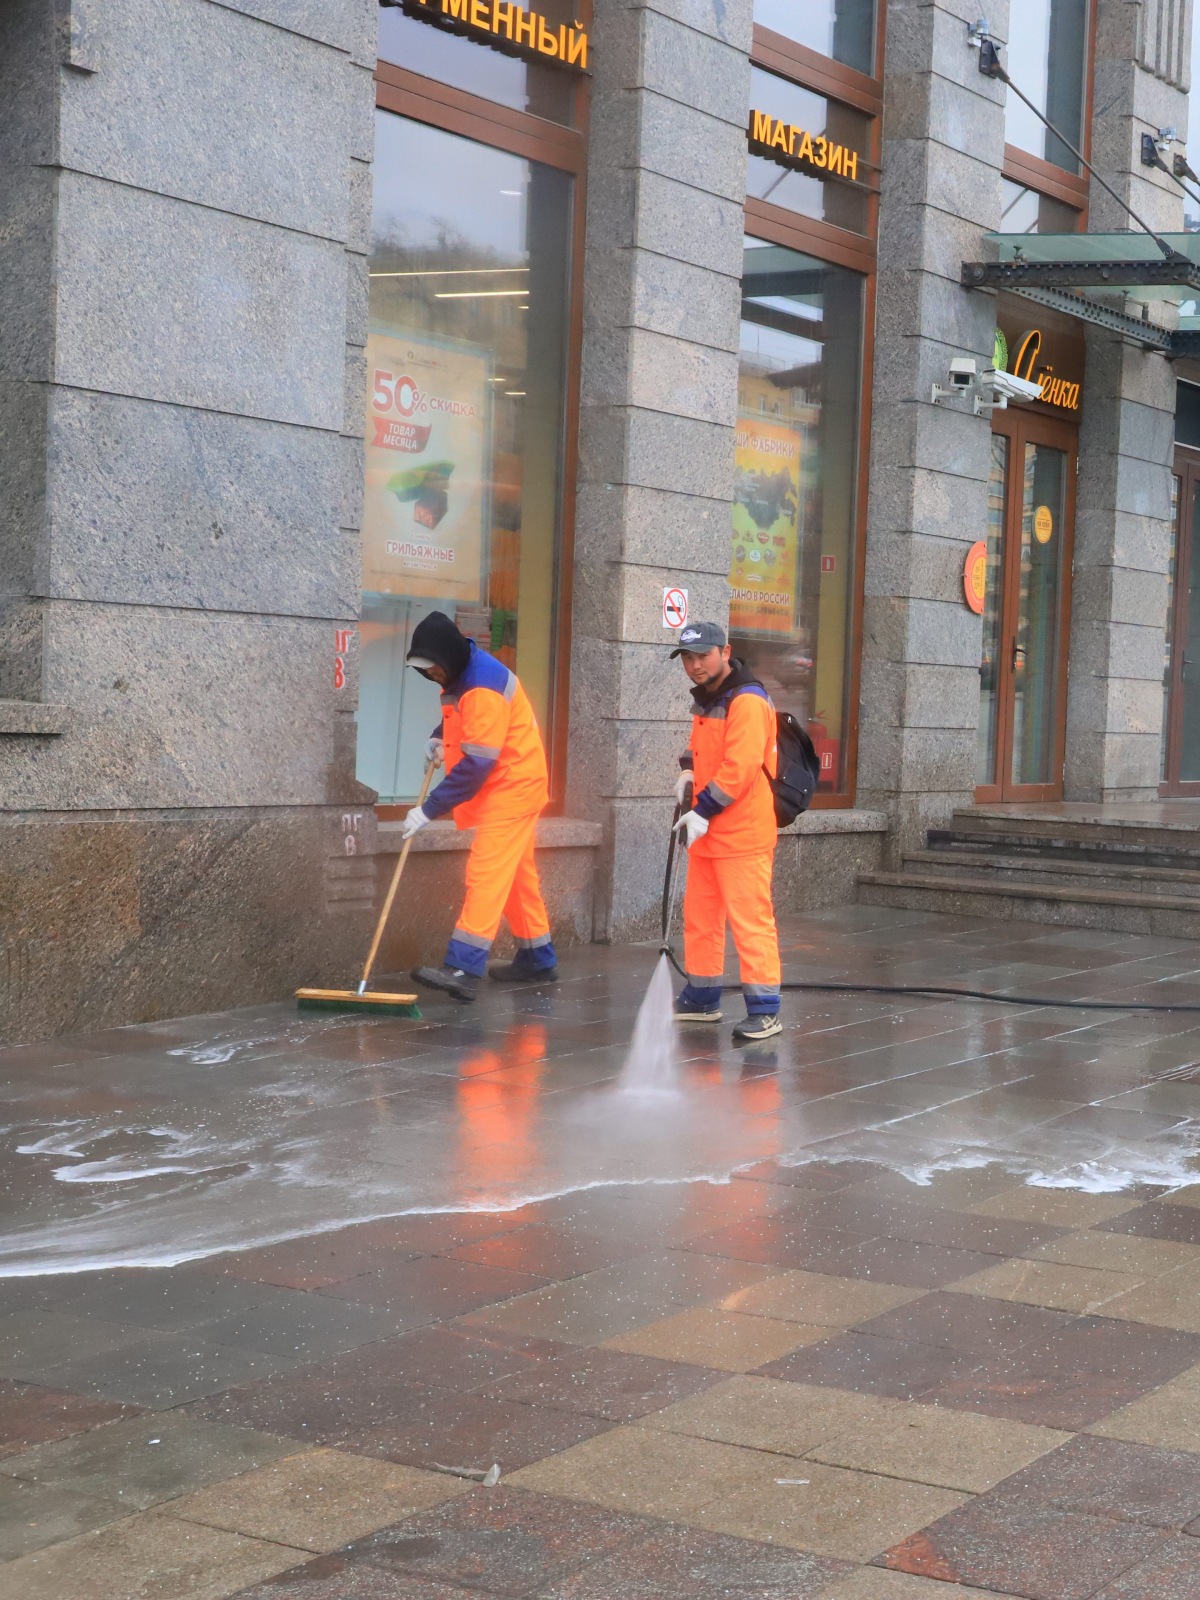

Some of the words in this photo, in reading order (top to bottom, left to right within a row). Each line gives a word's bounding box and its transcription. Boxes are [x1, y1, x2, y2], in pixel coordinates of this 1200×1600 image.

[419, 0, 587, 69] МЕННЫЙ
[753, 109, 857, 180] МАГАЗИН
[430, 397, 475, 417] СКИДКА
[389, 423, 416, 437] ТОВАР
[383, 434, 417, 450] МЕСЯЦА
[751, 437, 795, 458] ФАБРИКИ
[386, 541, 454, 561] ГРИЛЬЯЖНЫЕ
[753, 591, 758, 601] В
[759, 592, 790, 605] РОССИИ
